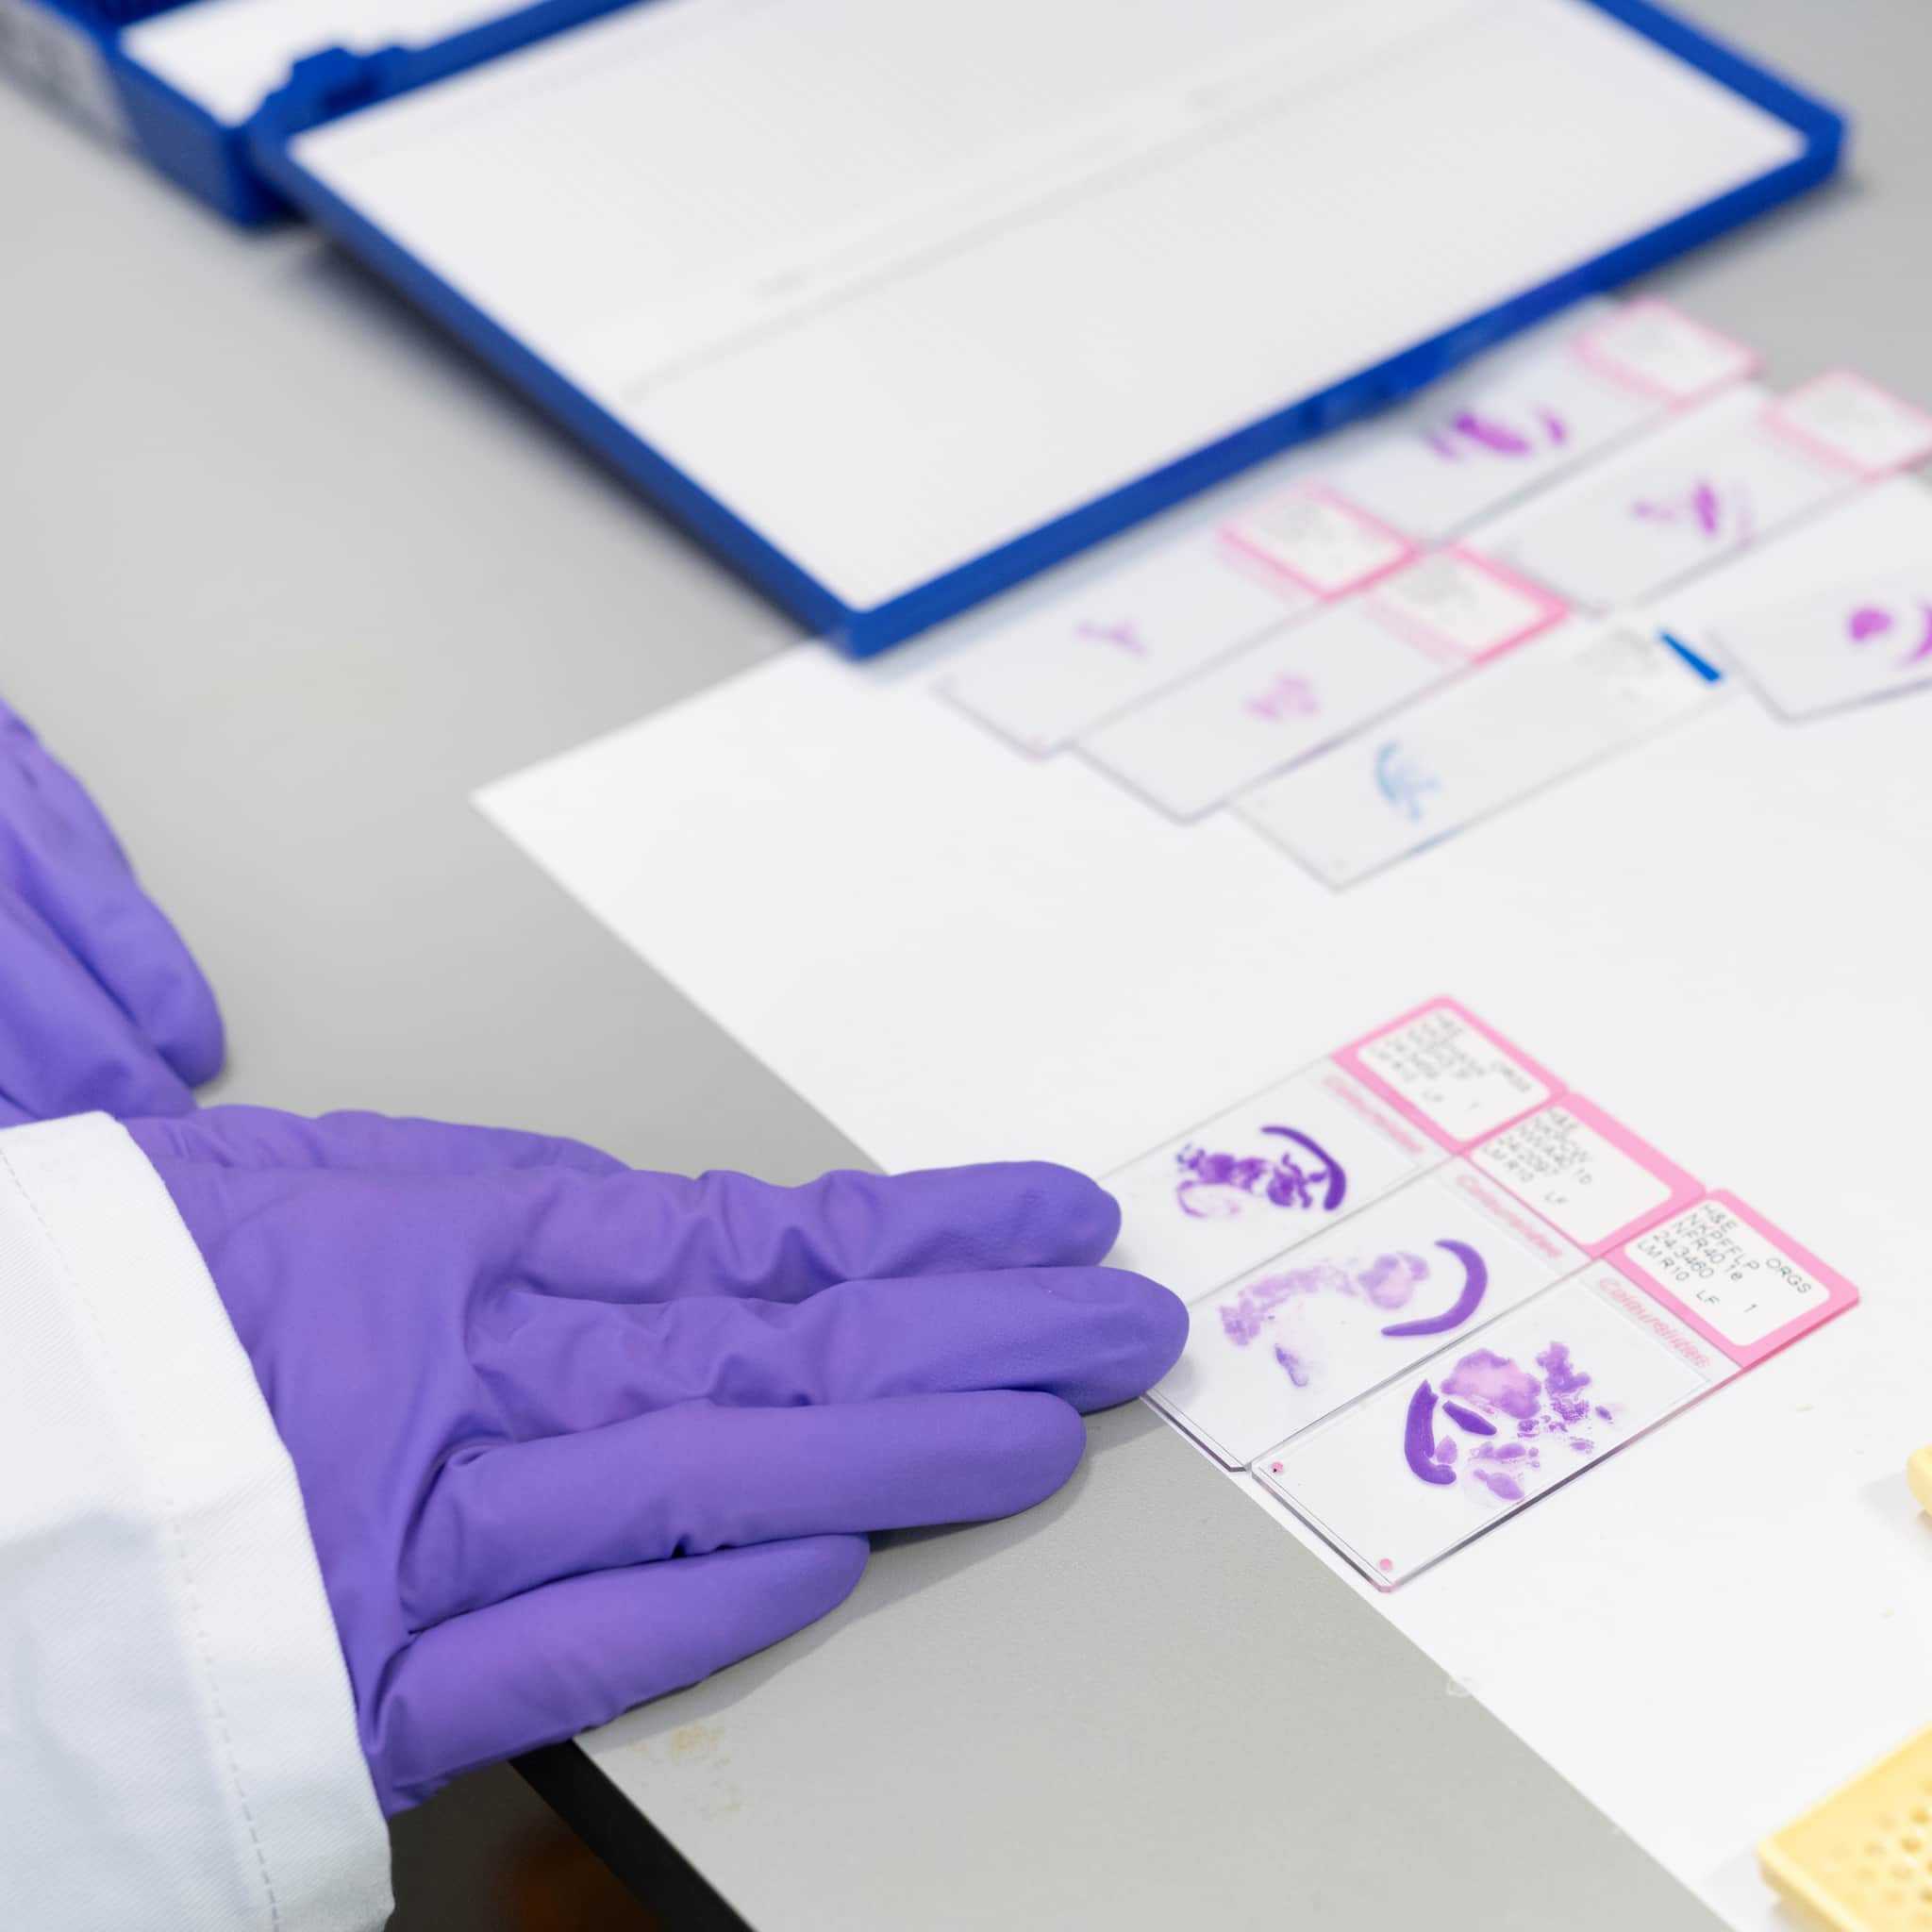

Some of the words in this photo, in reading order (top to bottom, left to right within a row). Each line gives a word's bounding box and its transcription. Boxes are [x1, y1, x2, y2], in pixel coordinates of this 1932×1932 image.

[1638, 1238, 1663, 1259] LM
[1660, 1257, 1690, 1281] R10
[1695, 1289, 1720, 1305] LF
[1702, 1203, 1738, 1234] H&E
[1765, 1257, 1811, 1294] ORGS
